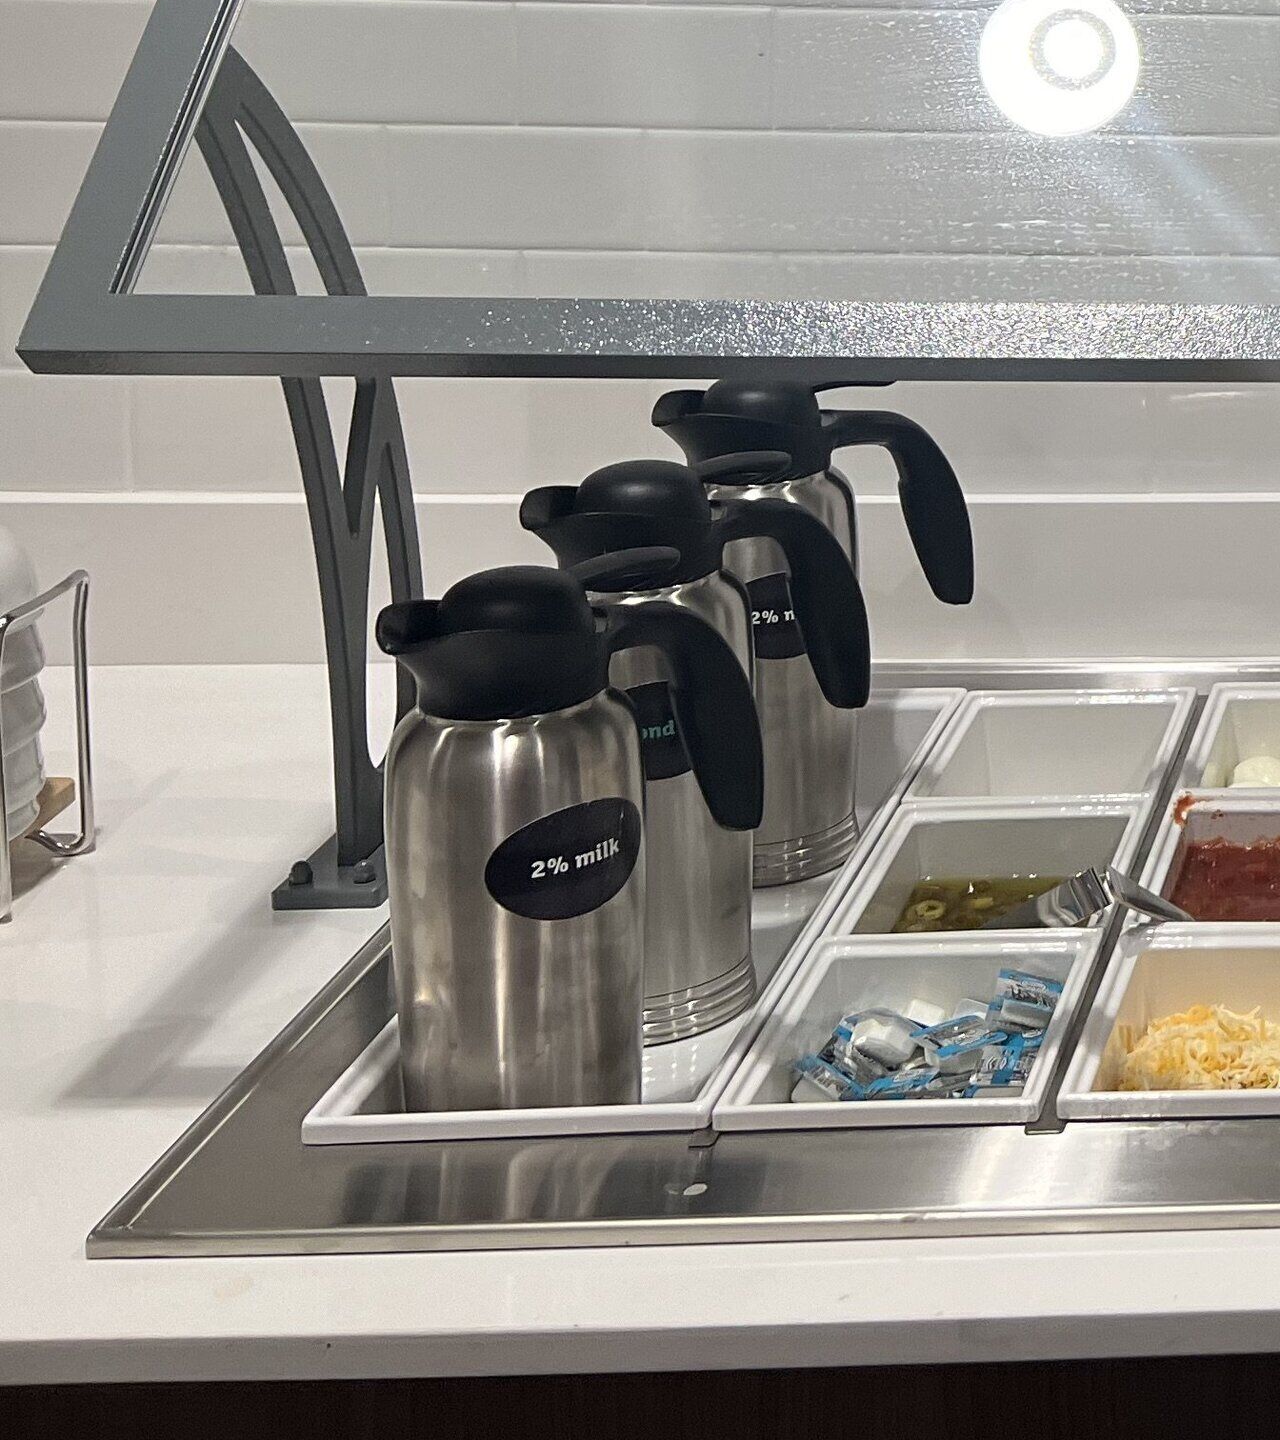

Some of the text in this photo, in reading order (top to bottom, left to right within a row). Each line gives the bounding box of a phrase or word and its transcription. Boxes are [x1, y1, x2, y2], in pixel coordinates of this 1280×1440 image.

[751, 609, 779, 625] 2%
[530, 837, 620, 879] 2% milk
